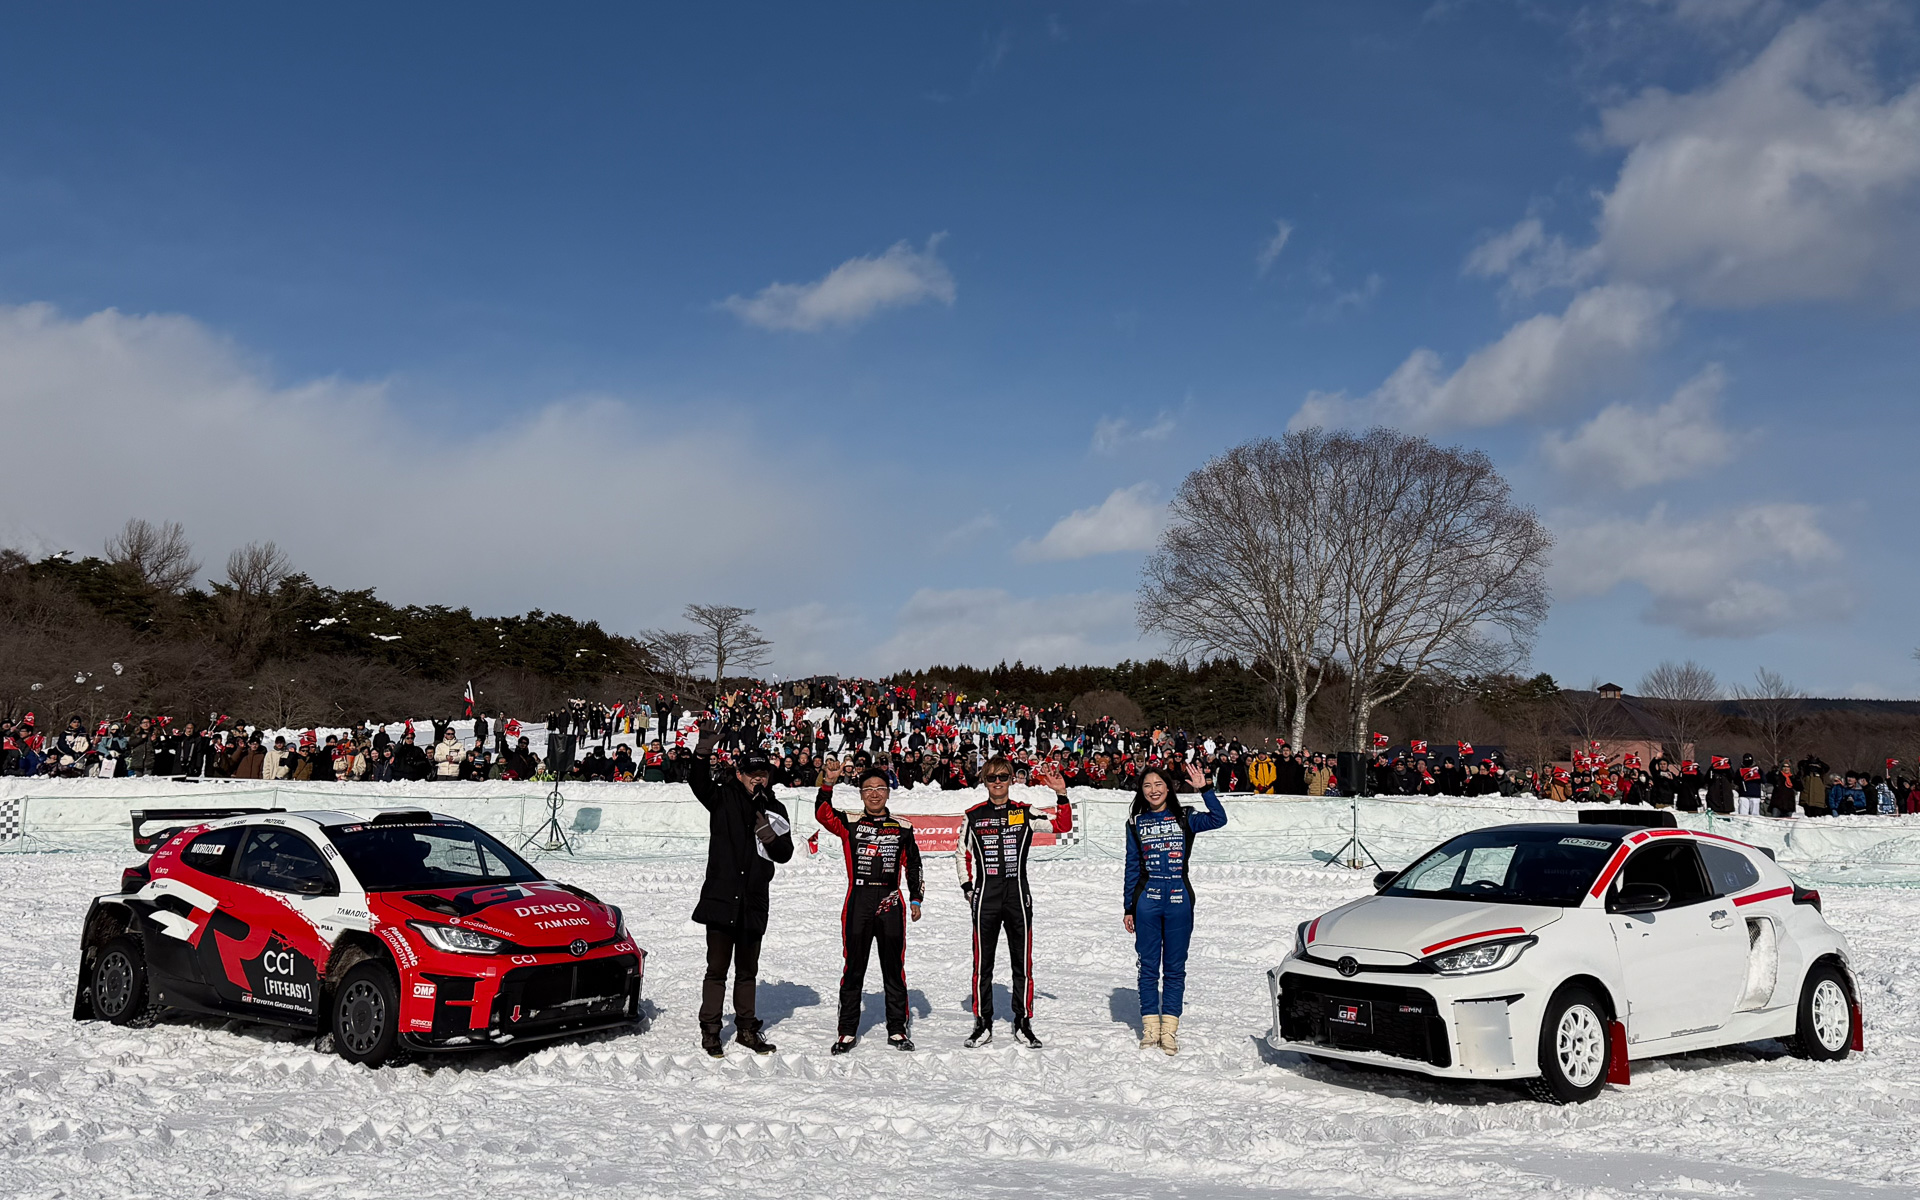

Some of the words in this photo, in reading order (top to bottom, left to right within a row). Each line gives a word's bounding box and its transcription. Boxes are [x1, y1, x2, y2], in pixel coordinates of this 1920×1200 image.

[191, 844, 214, 854] MORIZO
[563, 838, 608, 848] KO-3919
[336, 908, 368, 918] TAMADIC
[514, 902, 581, 918] DENSO
[463, 920, 514, 938] codebeamer
[534, 918, 590, 930] TAMADIC
[381, 929, 410, 970] AUTOMOTIVE
[388, 926, 418, 966] Panasonic
[413, 985, 436, 996] OMP
[252, 997, 274, 1006] TOYOTA
[274, 1001, 294, 1010] GAZOO
[294, 1004, 312, 1014] Racing
[1338, 1010, 1357, 1020] GR
